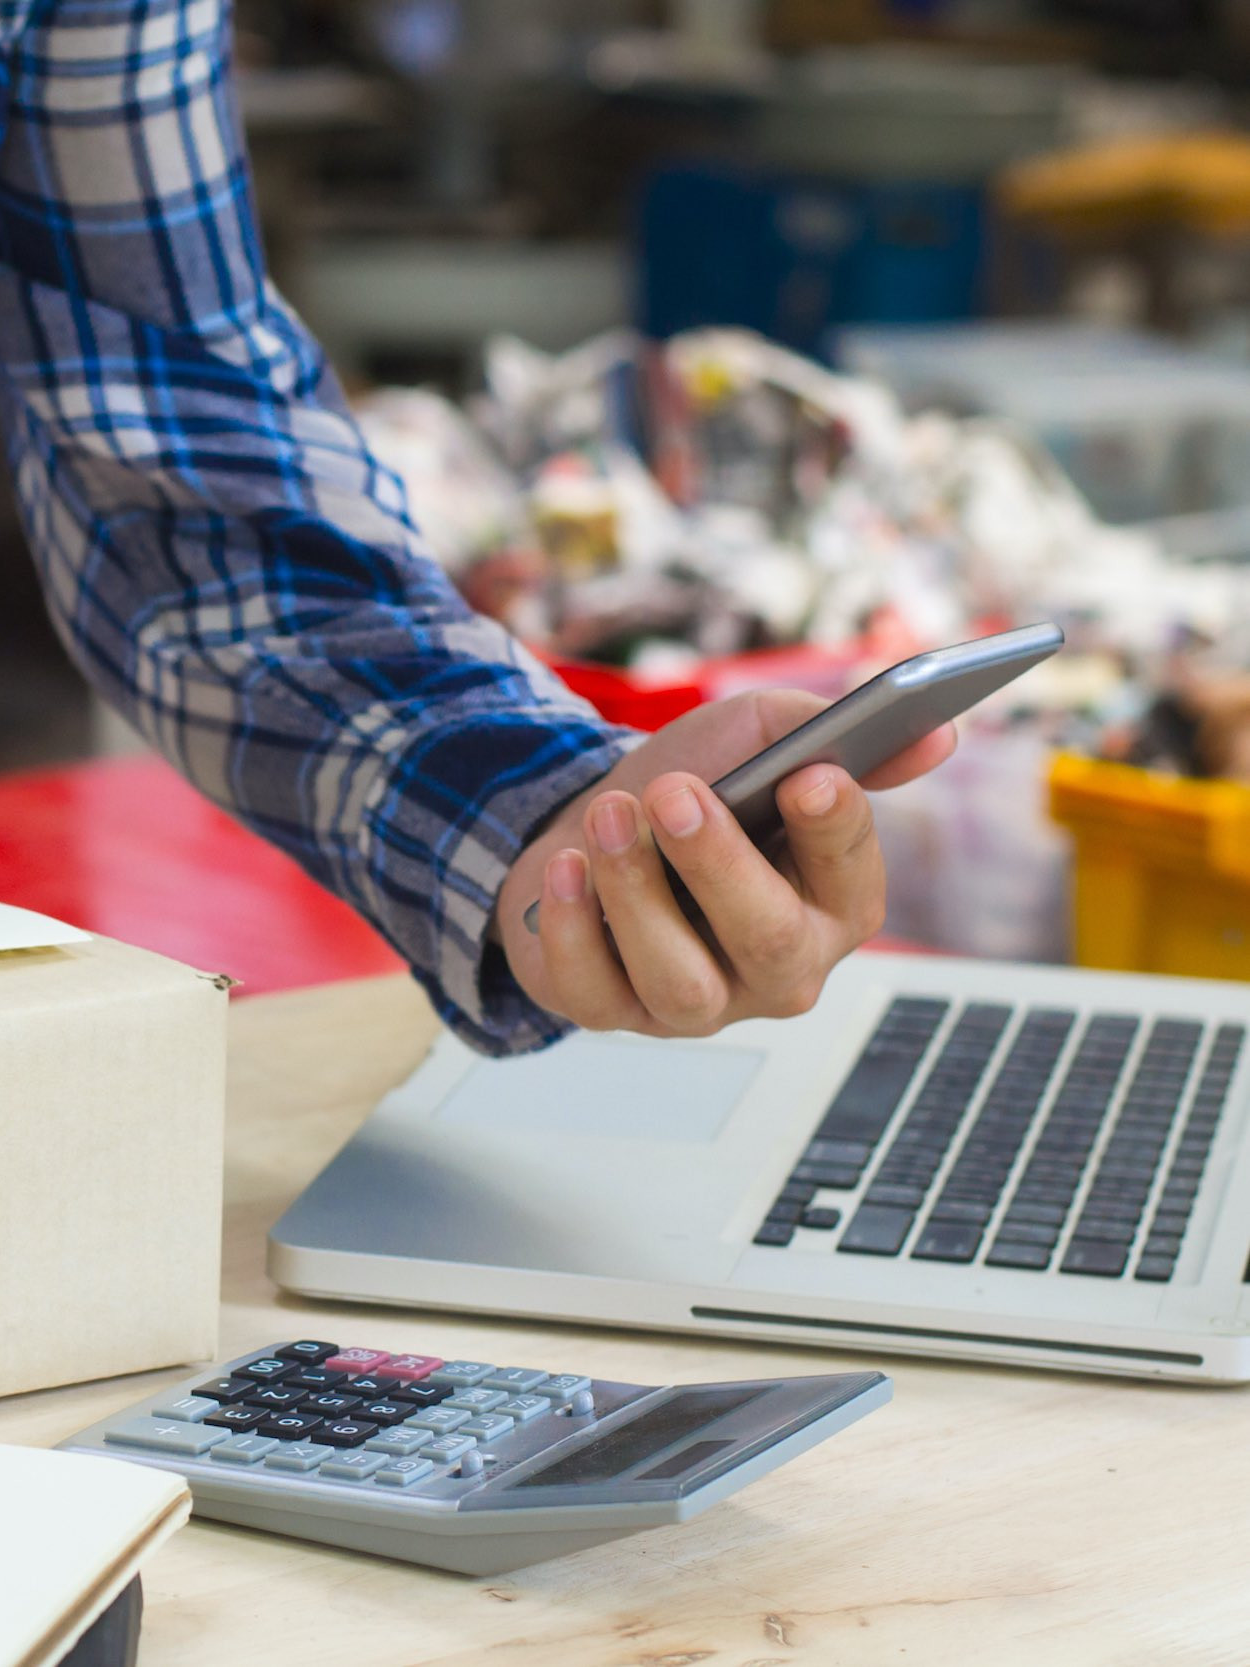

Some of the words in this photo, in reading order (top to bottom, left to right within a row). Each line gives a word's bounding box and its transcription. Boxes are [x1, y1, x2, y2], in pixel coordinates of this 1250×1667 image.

[294, 1343, 320, 1352] 0
[248, 1359, 284, 1373] 00
[393, 1356, 425, 1368] AC
[302, 1374, 326, 1382] 1
[354, 1379, 377, 1389] 4
[261, 1390, 290, 1400] 2
[410, 1388, 436, 1396] 7
[318, 1396, 345, 1406] 5
[224, 1410, 251, 1419] 3
[370, 1405, 397, 1414] 8
[278, 1417, 304, 1428] 6
[332, 1424, 359, 1435] 9
